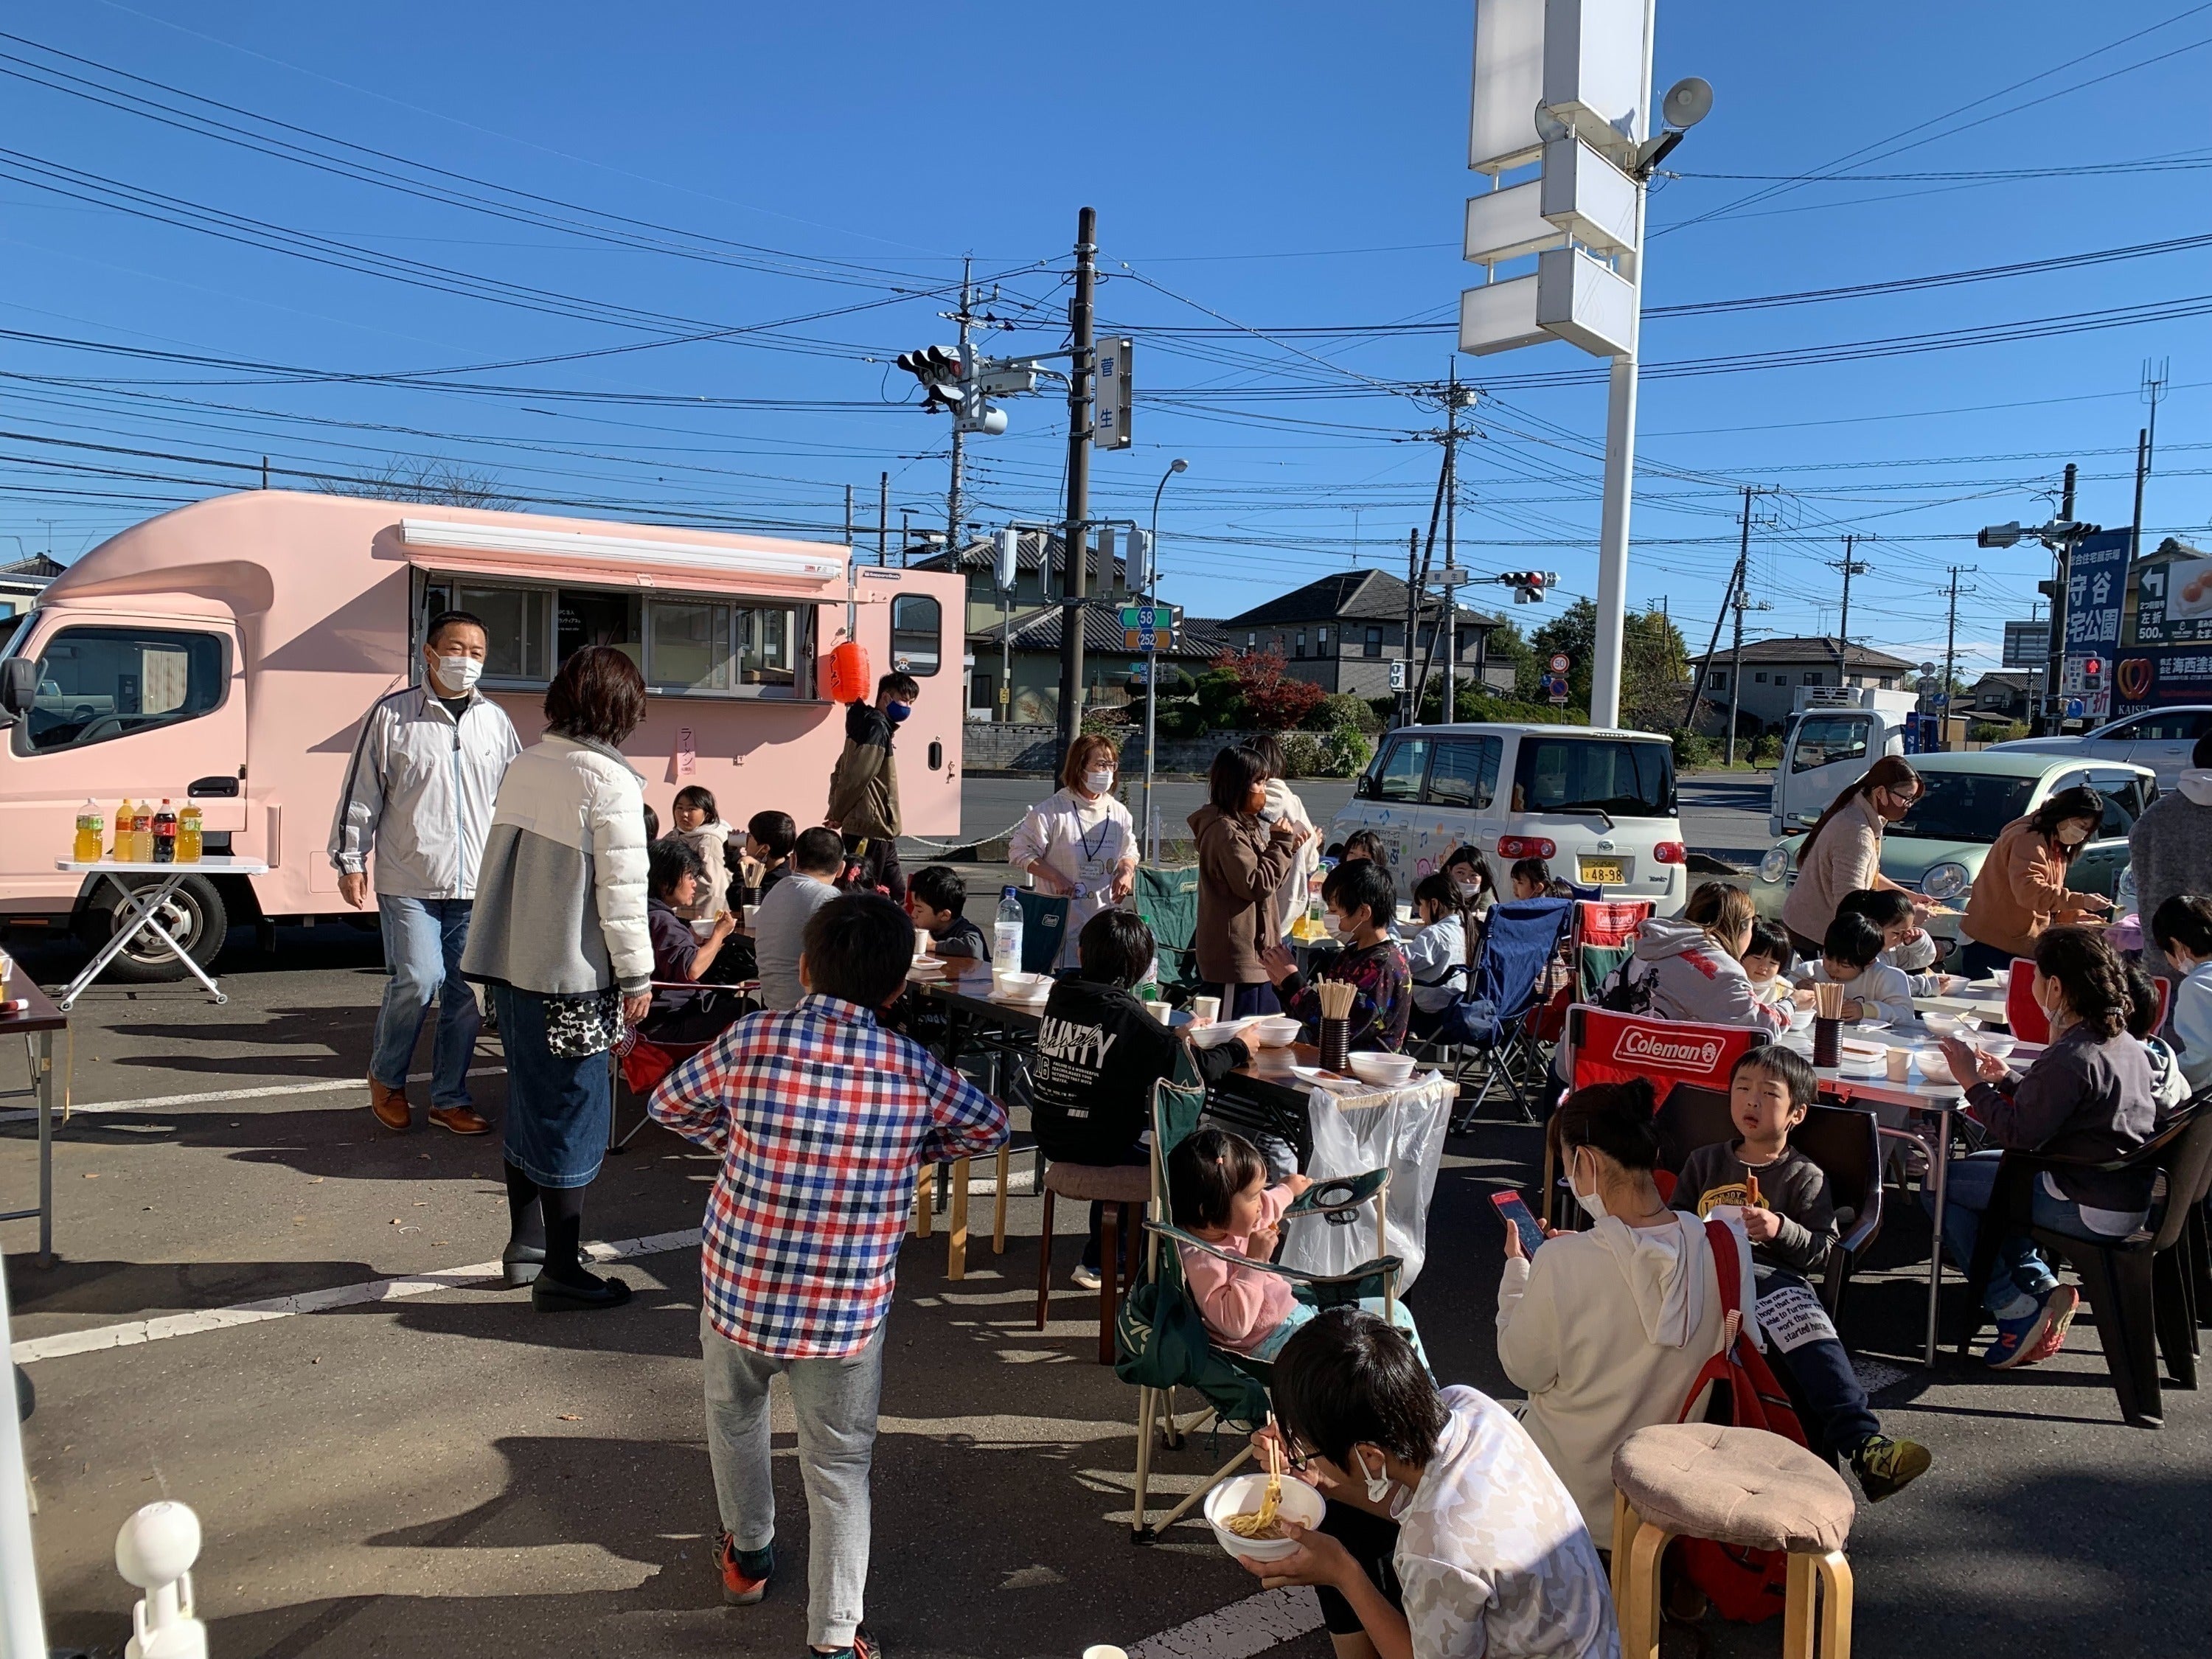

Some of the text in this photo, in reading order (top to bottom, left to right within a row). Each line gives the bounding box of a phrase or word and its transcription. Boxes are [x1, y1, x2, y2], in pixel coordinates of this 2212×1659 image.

[2070, 571, 2112, 606] 守谷
[1140, 611, 1152, 624] 58
[2065, 608, 2119, 643] 宅公園
[2141, 611, 2162, 625] 左折
[1140, 634, 1155, 646] 252
[681, 728, 693, 766] ラーメン
[1591, 869, 1622, 881] 48-98
[1626, 1032, 1701, 1061] Coleman
[1773, 1291, 1787, 1301] near
[1758, 1307, 1775, 1319] hope
[1775, 1298, 1790, 1309] that
[1766, 1317, 1780, 1326] able
[1787, 1304, 1812, 1315] further
[1777, 1320, 1795, 1332] work
[1793, 1313, 1810, 1324] that
[1784, 1324, 1810, 1342] started
